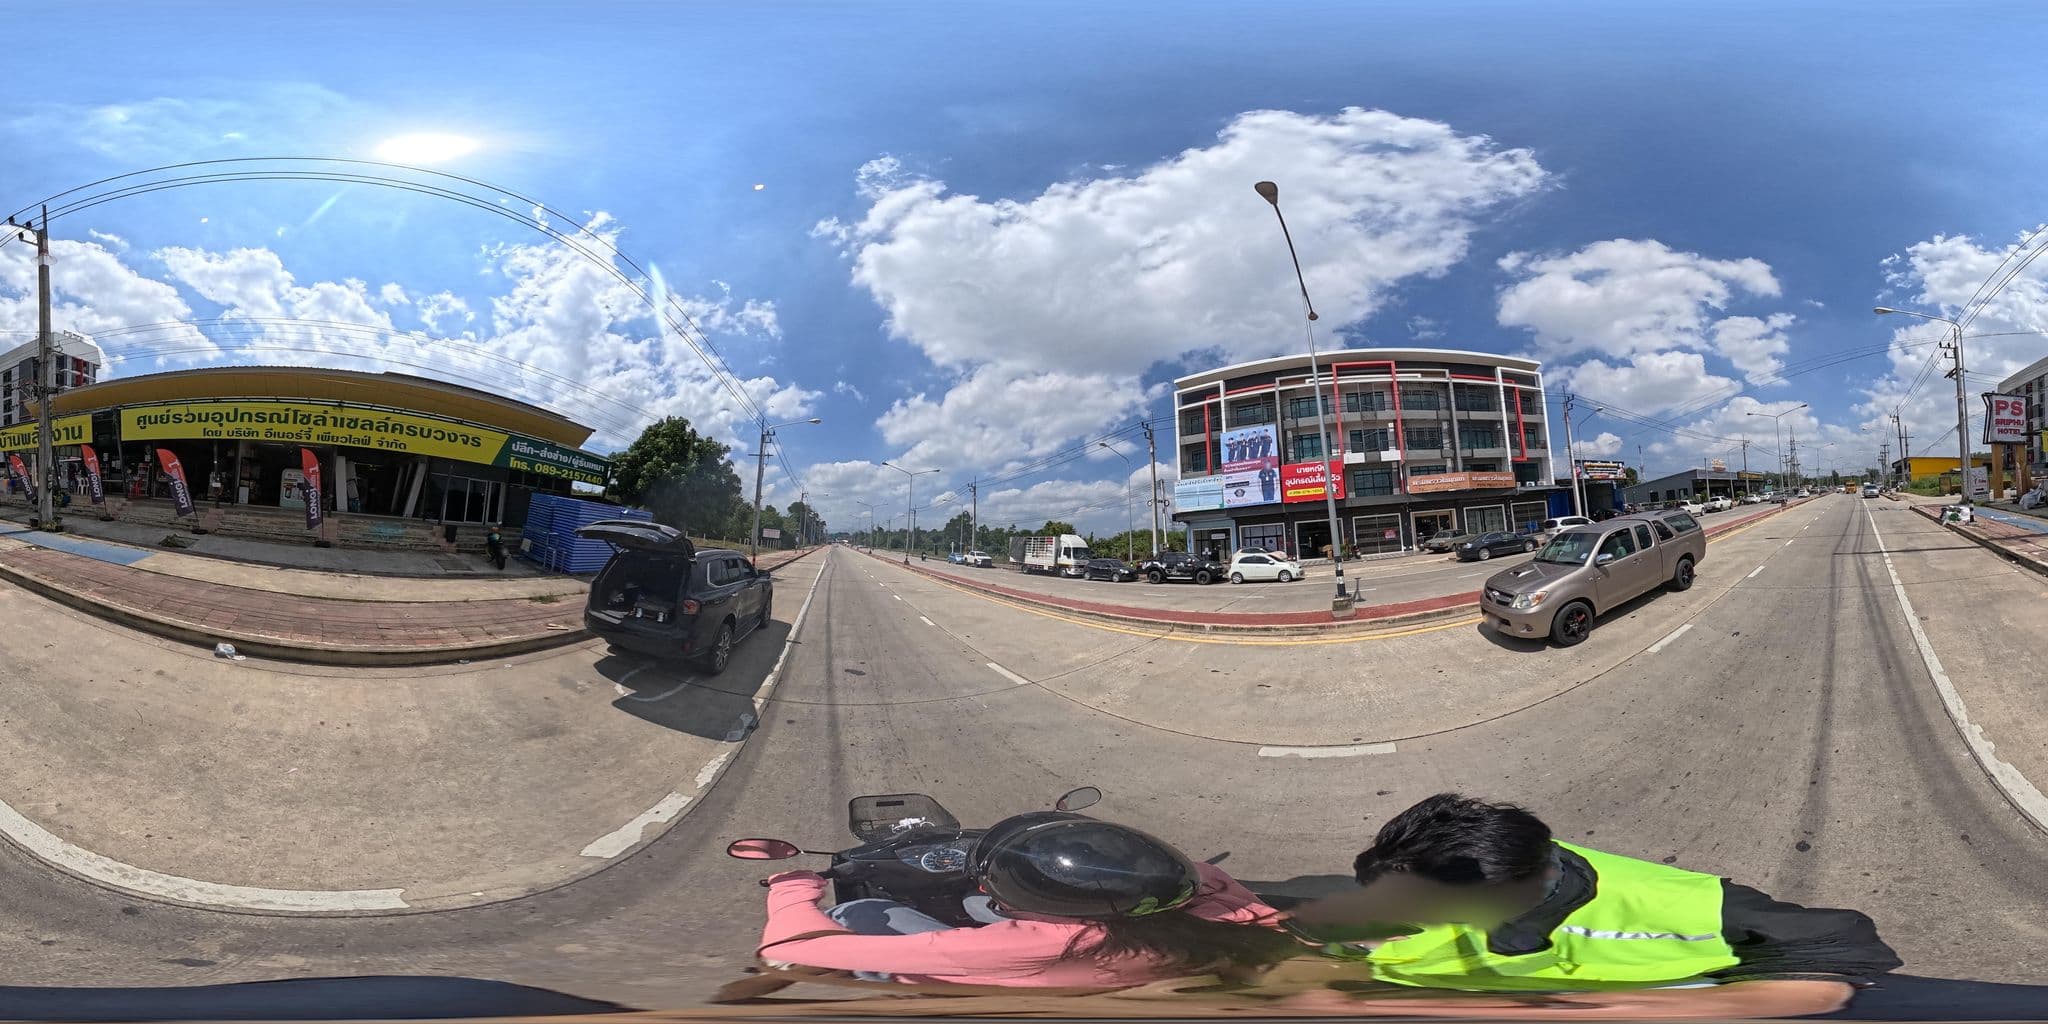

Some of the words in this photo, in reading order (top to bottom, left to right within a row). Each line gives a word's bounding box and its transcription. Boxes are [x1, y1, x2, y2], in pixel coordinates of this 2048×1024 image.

[1995, 399, 2024, 417] PS
[1995, 418, 2025, 426] SRIPHU
[0, 424, 83, 449] บ้านพลังาน
[203, 427, 222, 438] โดย
[226, 427, 259, 438] บริษัท
[376, 437, 407, 450] จำกัด
[509, 457, 530, 471] โทร.
[534, 463, 603, 485] 089-2157440
